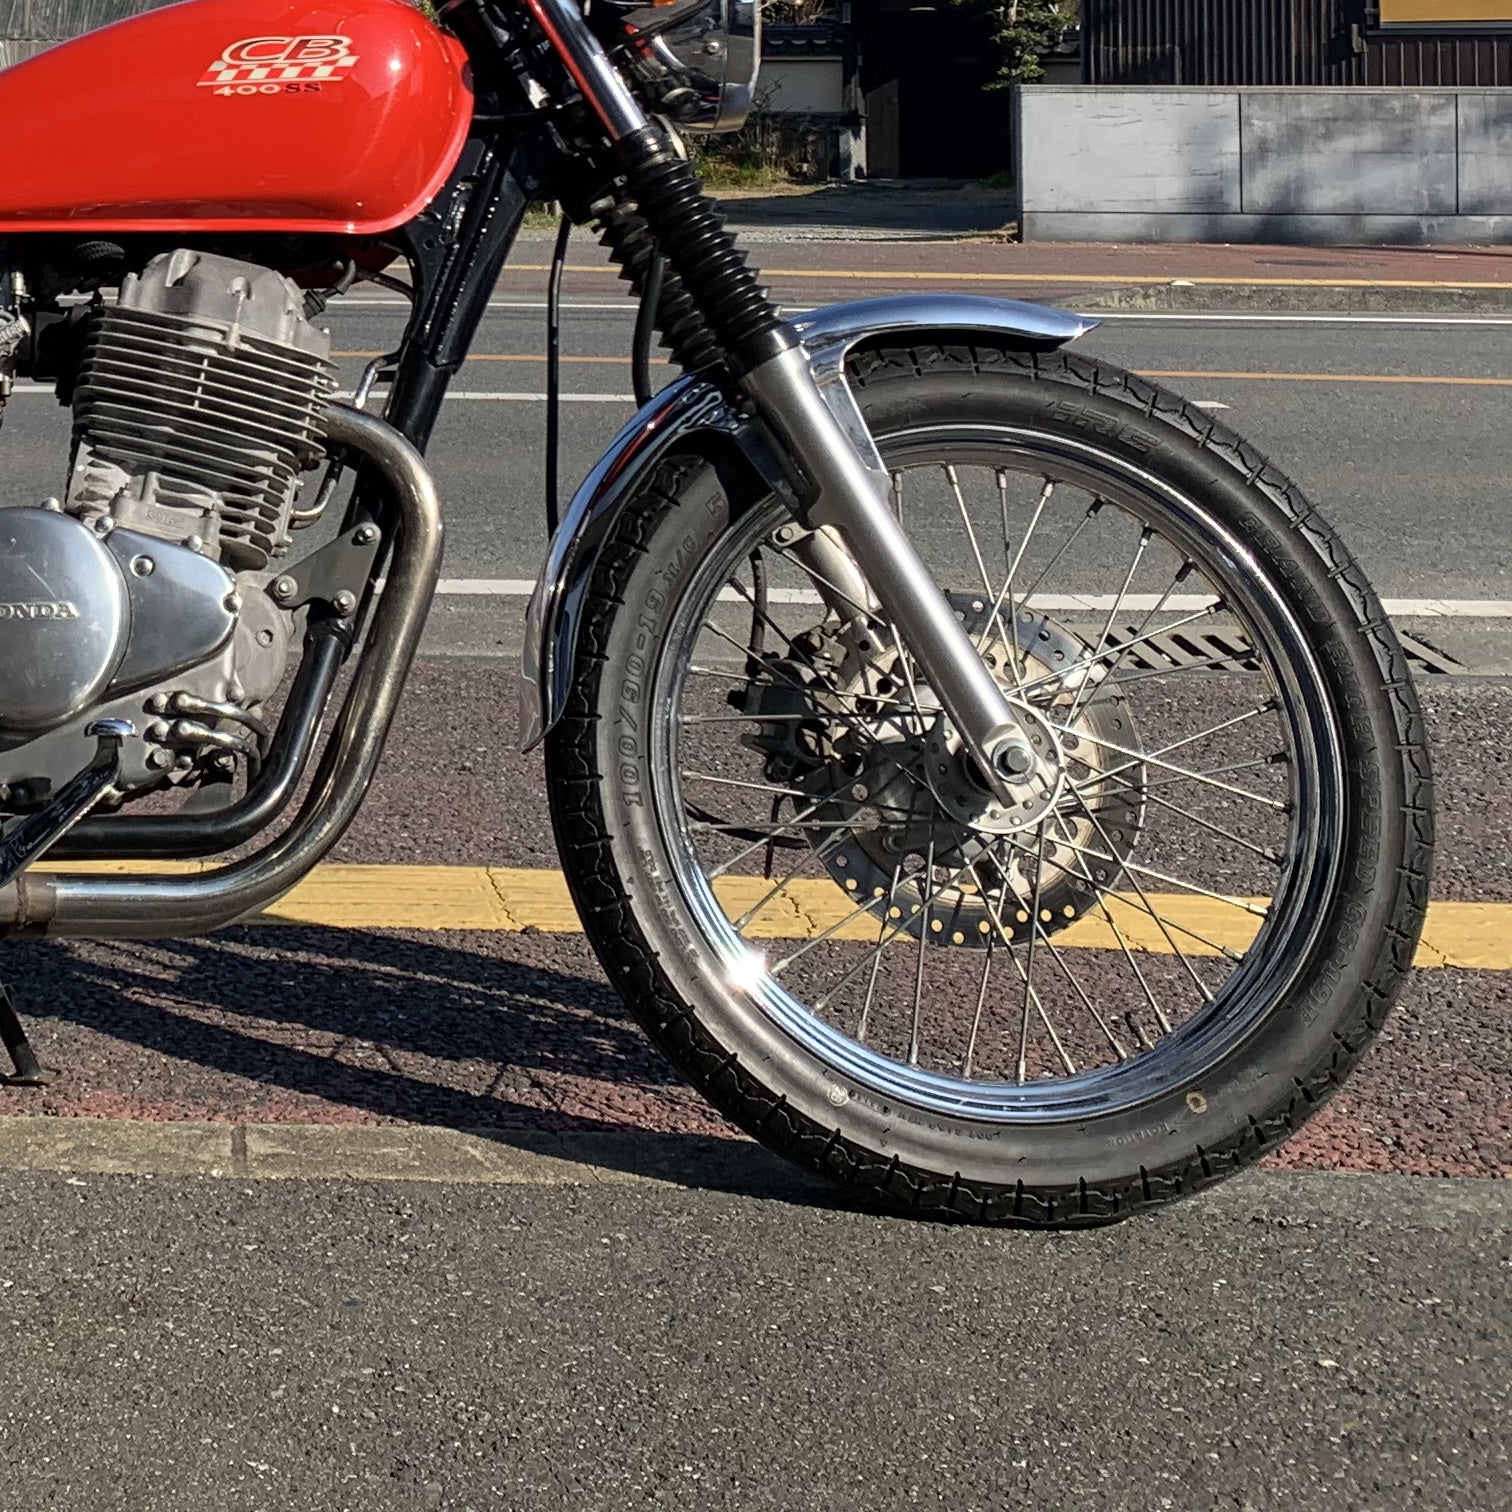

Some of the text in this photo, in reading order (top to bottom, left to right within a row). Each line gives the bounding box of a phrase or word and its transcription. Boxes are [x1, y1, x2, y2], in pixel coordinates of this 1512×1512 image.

[213, 82, 321, 97] 400SS
[221, 35, 352, 65] CB
[618, 588, 666, 808] 100/90-19
[1238, 510, 1332, 628] GRAND
[1324, 637, 1374, 744] HIGH
[1356, 759, 1382, 888] SPEED
